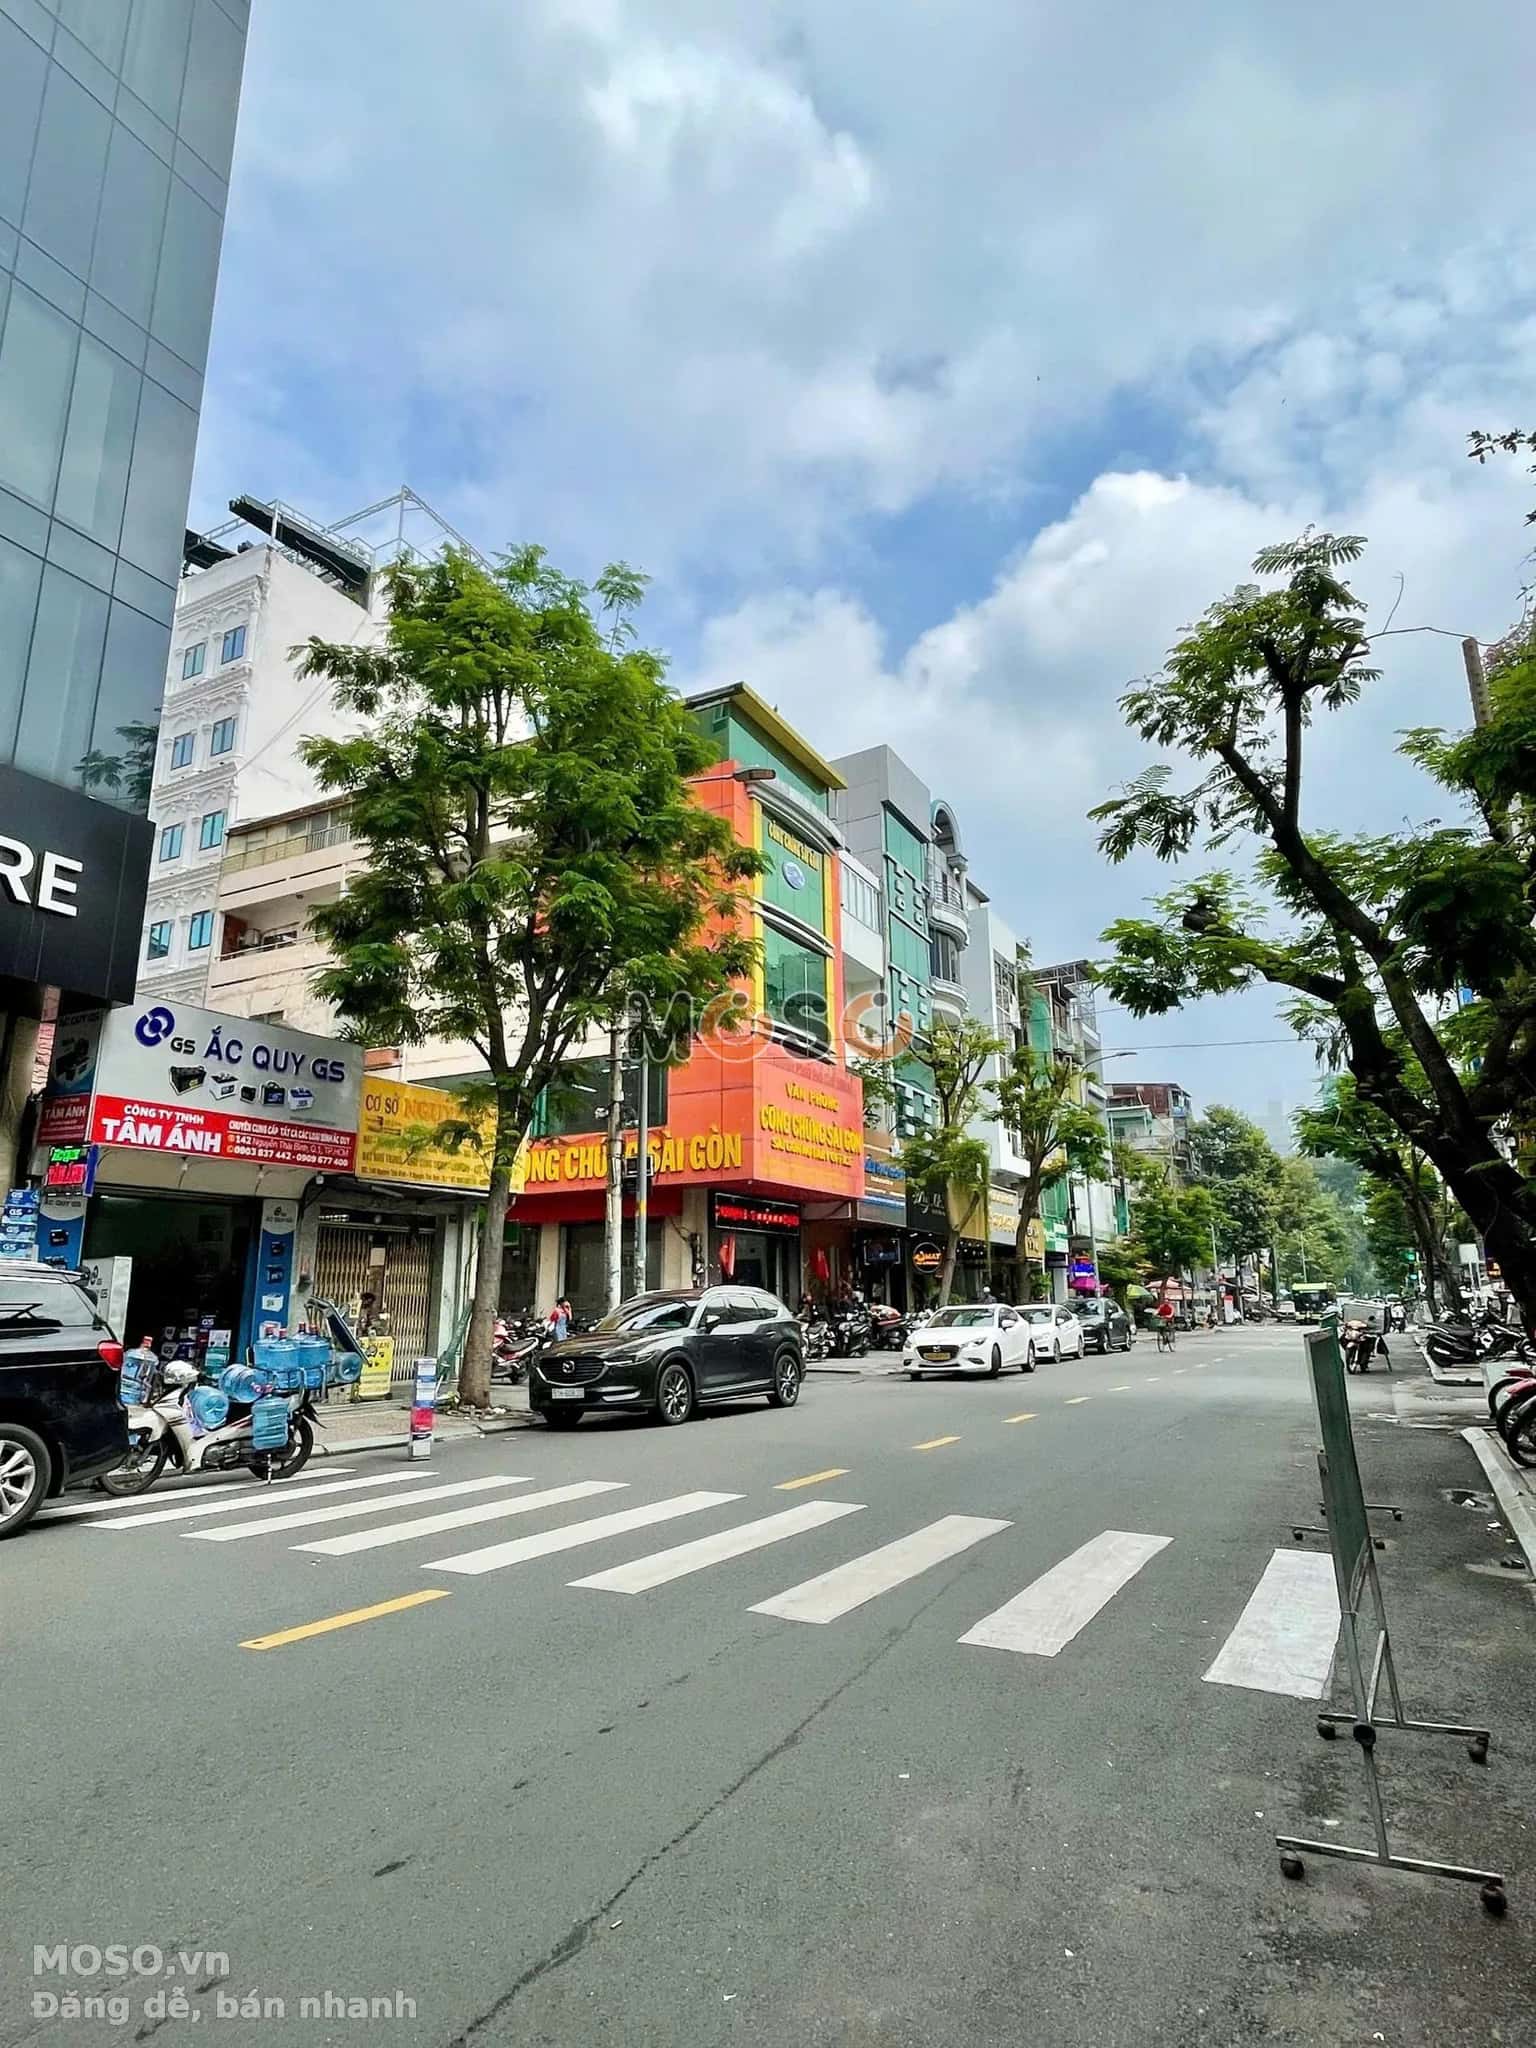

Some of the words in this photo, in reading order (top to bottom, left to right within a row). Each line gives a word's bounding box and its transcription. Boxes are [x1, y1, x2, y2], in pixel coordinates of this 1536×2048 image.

[170, 1037, 196, 1055] GS
[204, 1025, 243, 1064] ẮC
[252, 1045, 306, 1075] QUY
[311, 1058, 345, 1082] GS
[365, 1094, 381, 1111] CƠ
[385, 1092, 399, 1115] SỞ
[124, 1104, 156, 1118] CÔNG
[158, 1109, 173, 1120] TY
[174, 1111, 204, 1124] TNHH
[759, 1104, 790, 1136] CÔNG
[101, 1116, 163, 1146] TÂM
[165, 1123, 222, 1153] ÁNH
[236, 1135, 251, 1145] 142
[233, 1145, 256, 1156] 0903
[275, 1151, 291, 1160] 442
[690, 1124, 742, 1170] GÒN
[9, 1208, 23, 1216] GS
[6, 1225, 20, 1234] GS
[2, 1243, 17, 1251] GS
